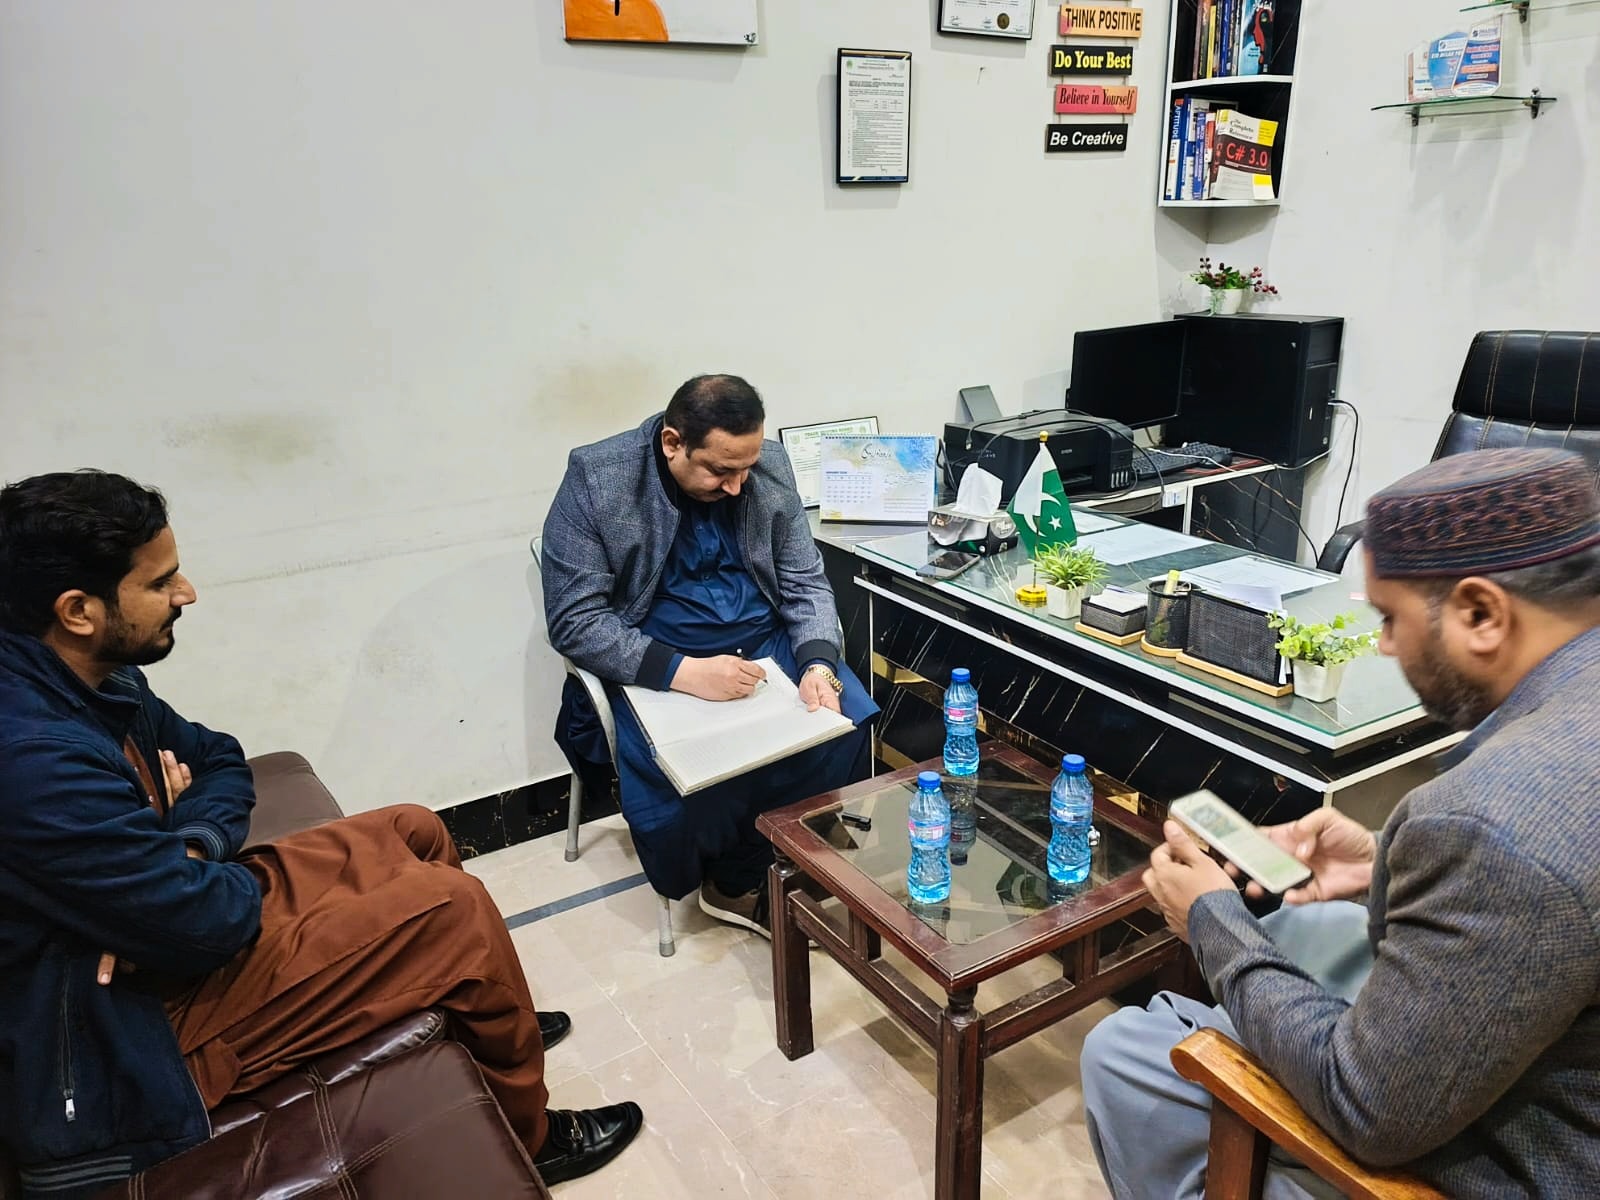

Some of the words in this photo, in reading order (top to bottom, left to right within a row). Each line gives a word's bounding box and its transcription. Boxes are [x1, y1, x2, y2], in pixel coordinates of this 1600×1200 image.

[1065, 8, 1096, 28] THINK
[1099, 10, 1142, 31] POSITIVE
[1054, 50, 1072, 68] Do
[1075, 51, 1103, 68] Your
[1106, 51, 1131, 69] Best
[1059, 87, 1089, 105] Believe
[1091, 89, 1099, 105] in
[1102, 88, 1135, 110] Yourself
[1050, 132, 1068, 146] Be
[1072, 131, 1124, 146] Creative
[1226, 143, 1246, 161] C#
[1248, 148, 1268, 167] 3.0
